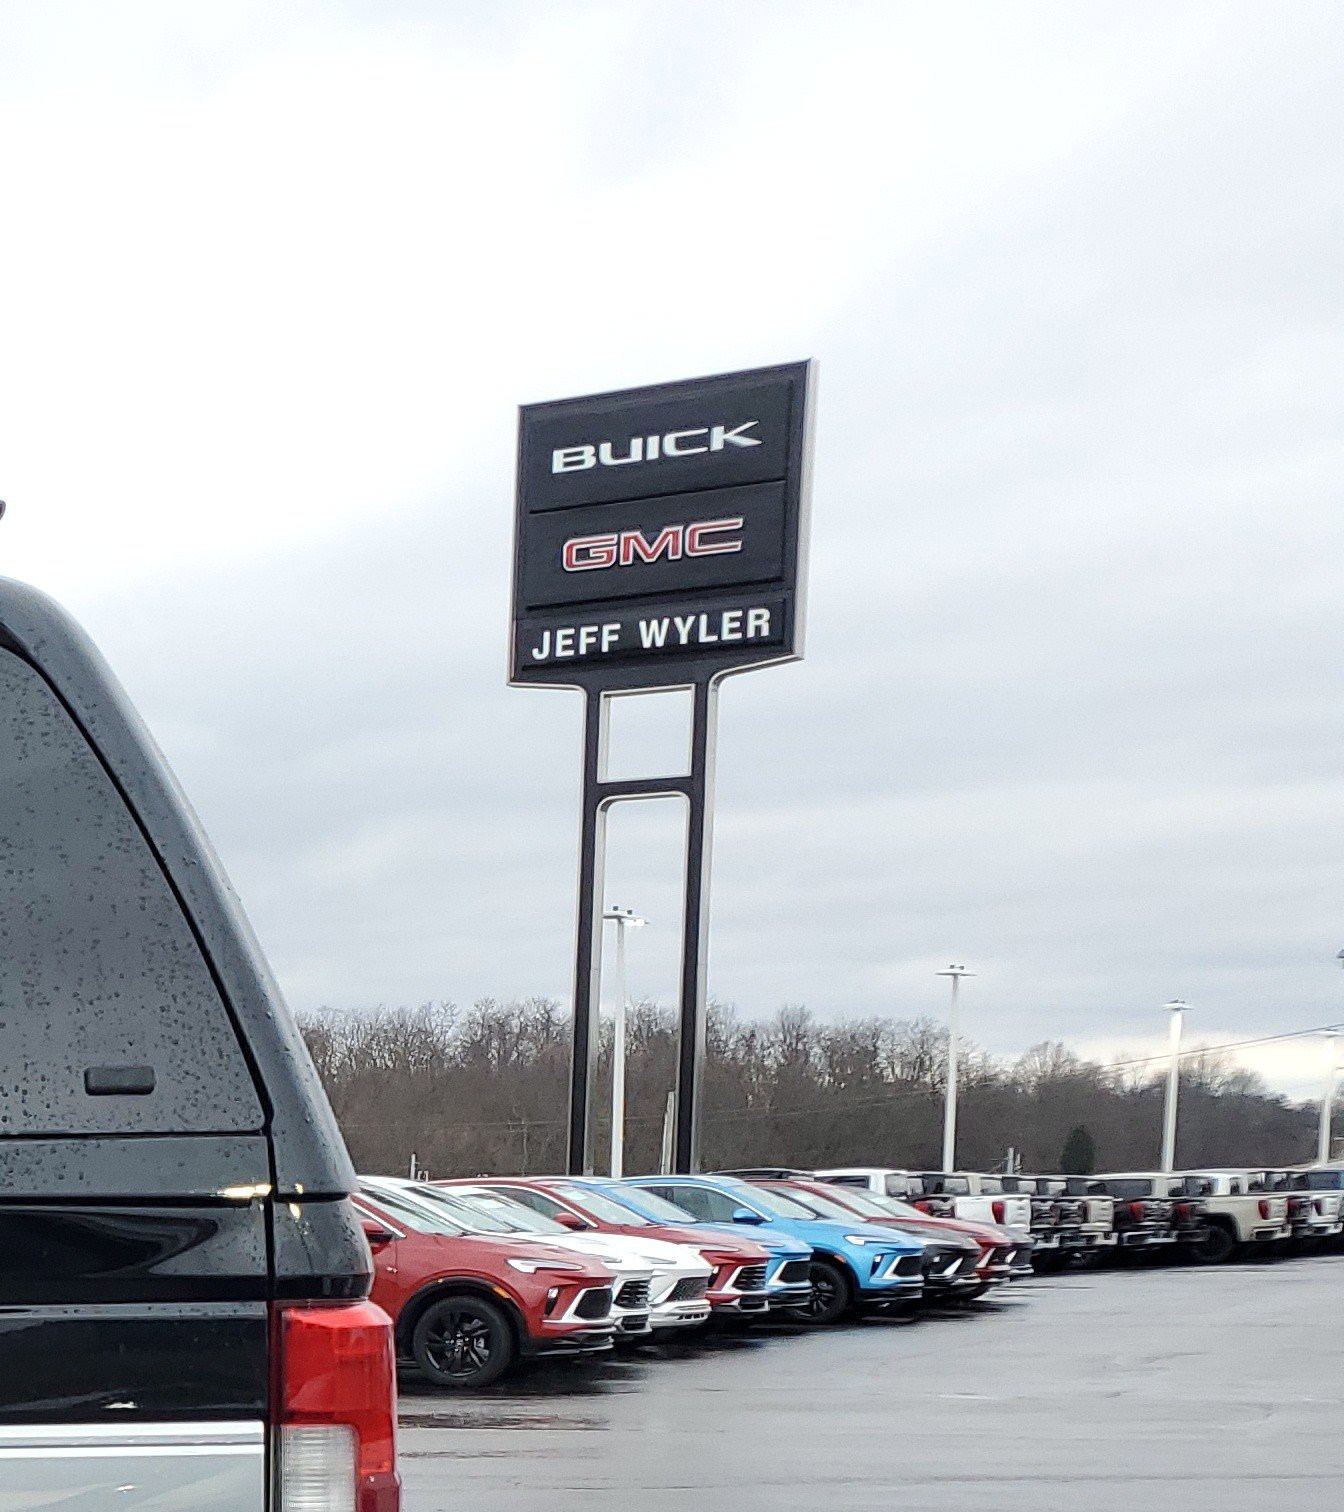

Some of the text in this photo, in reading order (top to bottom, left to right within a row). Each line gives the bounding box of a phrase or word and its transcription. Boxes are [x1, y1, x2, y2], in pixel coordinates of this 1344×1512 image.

[551, 420, 763, 474] BUICK
[562, 517, 744, 573] GMC
[531, 607, 771, 661] JEFF WYLER
